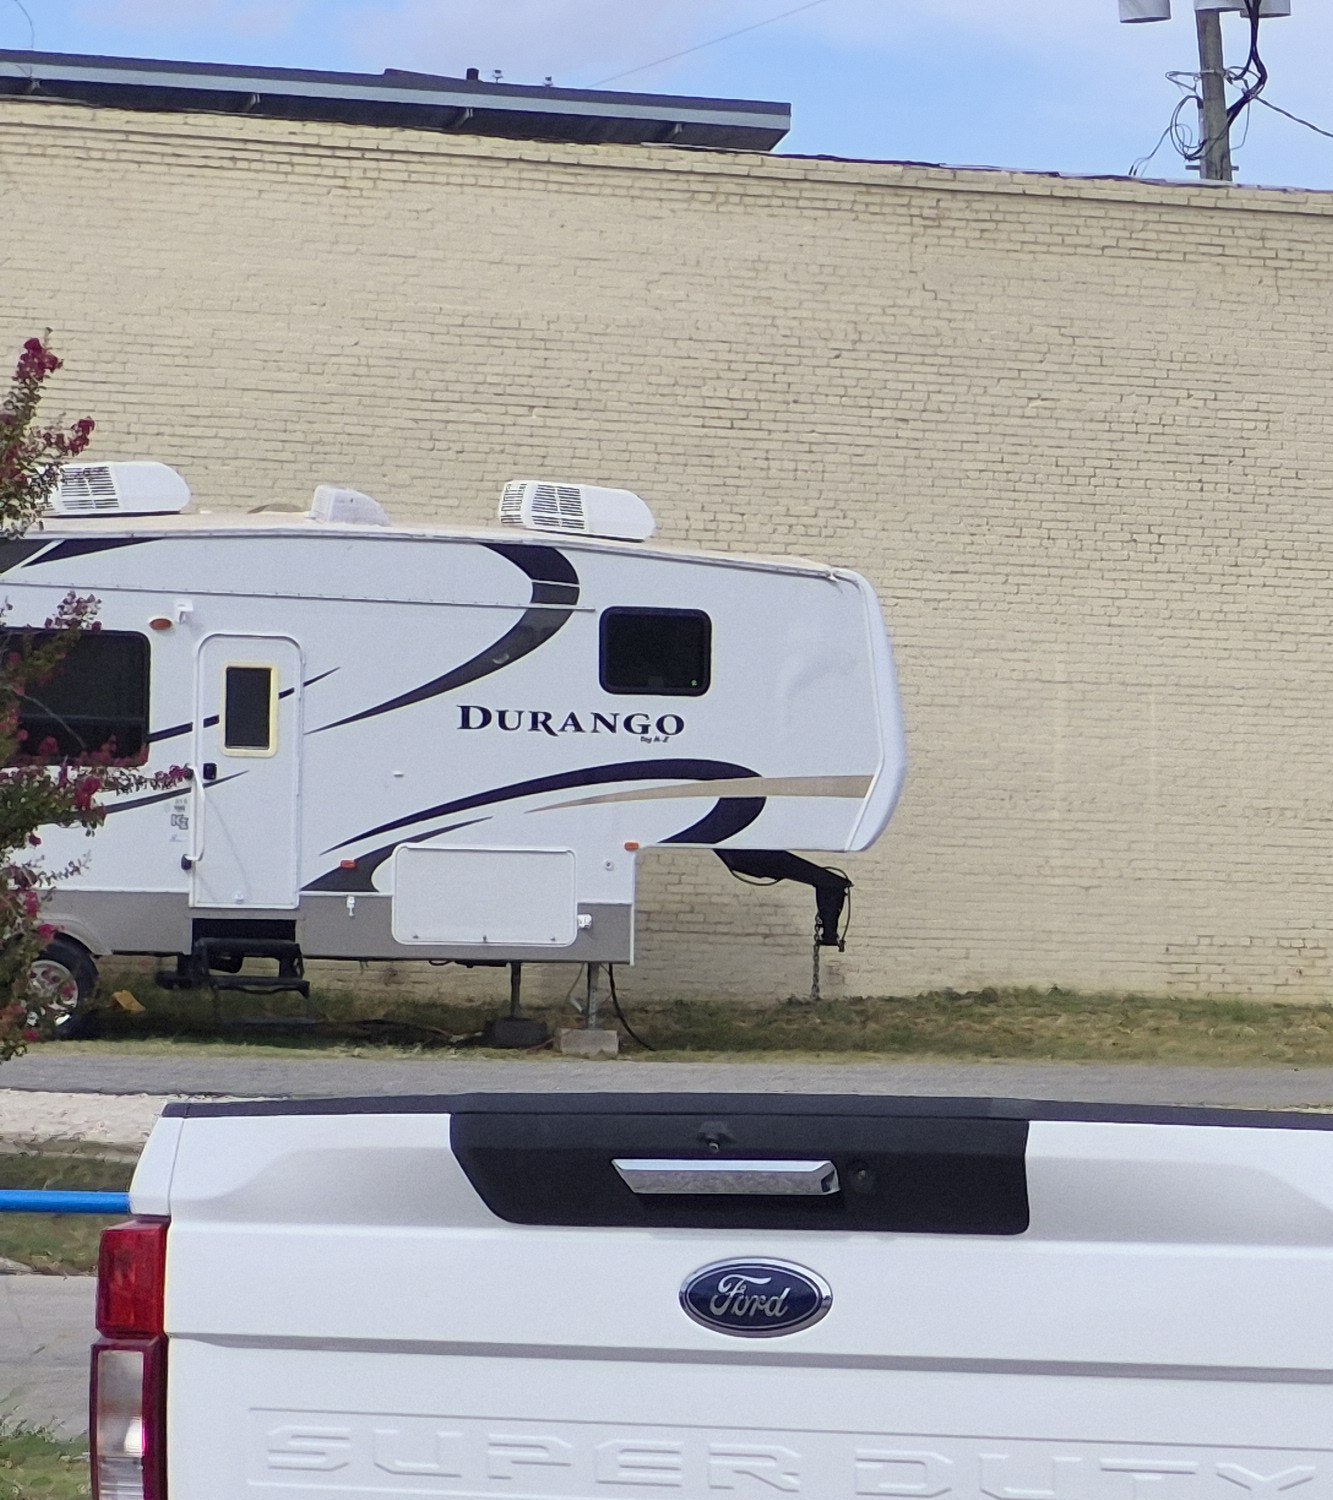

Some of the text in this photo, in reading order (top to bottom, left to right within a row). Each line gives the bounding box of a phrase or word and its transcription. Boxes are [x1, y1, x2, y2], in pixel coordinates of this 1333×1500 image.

[456, 704, 685, 737] DURANGO
[709, 1273, 791, 1317] Ford
[266, 1426, 802, 1493] SUPER
